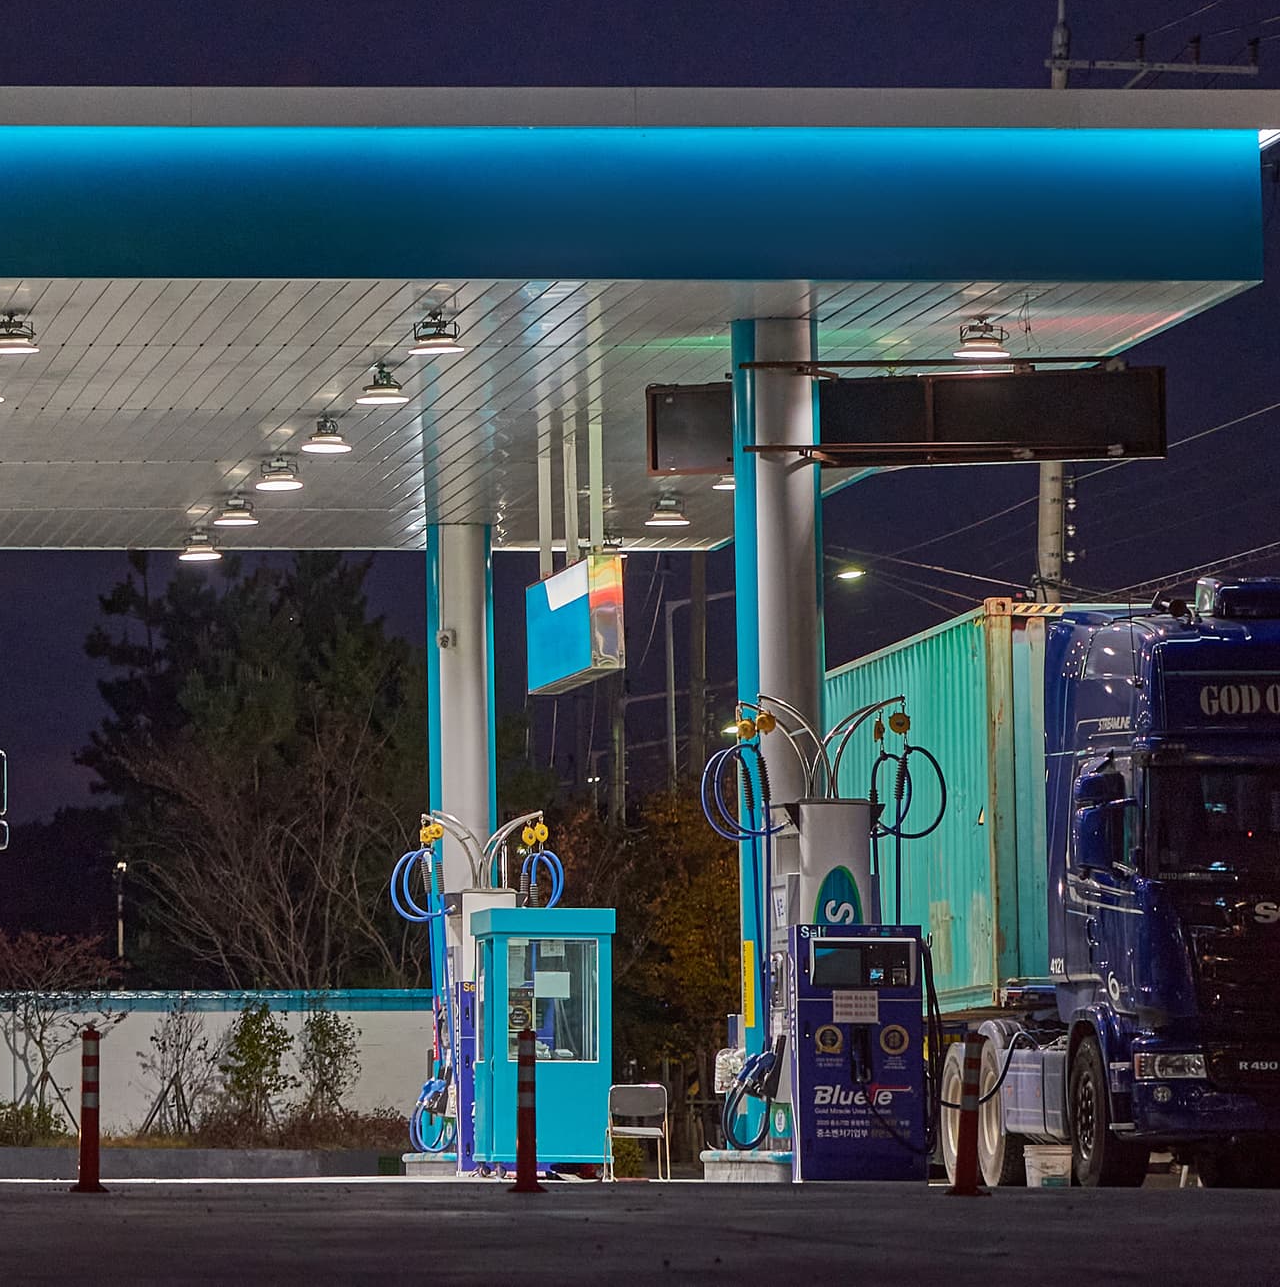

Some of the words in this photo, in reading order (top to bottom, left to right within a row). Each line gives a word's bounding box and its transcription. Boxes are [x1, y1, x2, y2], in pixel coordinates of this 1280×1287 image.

[1200, 685, 1261, 715] GOD
[1098, 716, 1131, 732] STREAMLINE
[800, 926, 827, 939] Self
[1050, 958, 1065, 974] 4121
[1239, 1062, 1248, 1070] R
[1251, 1062, 1278, 1070] 490
